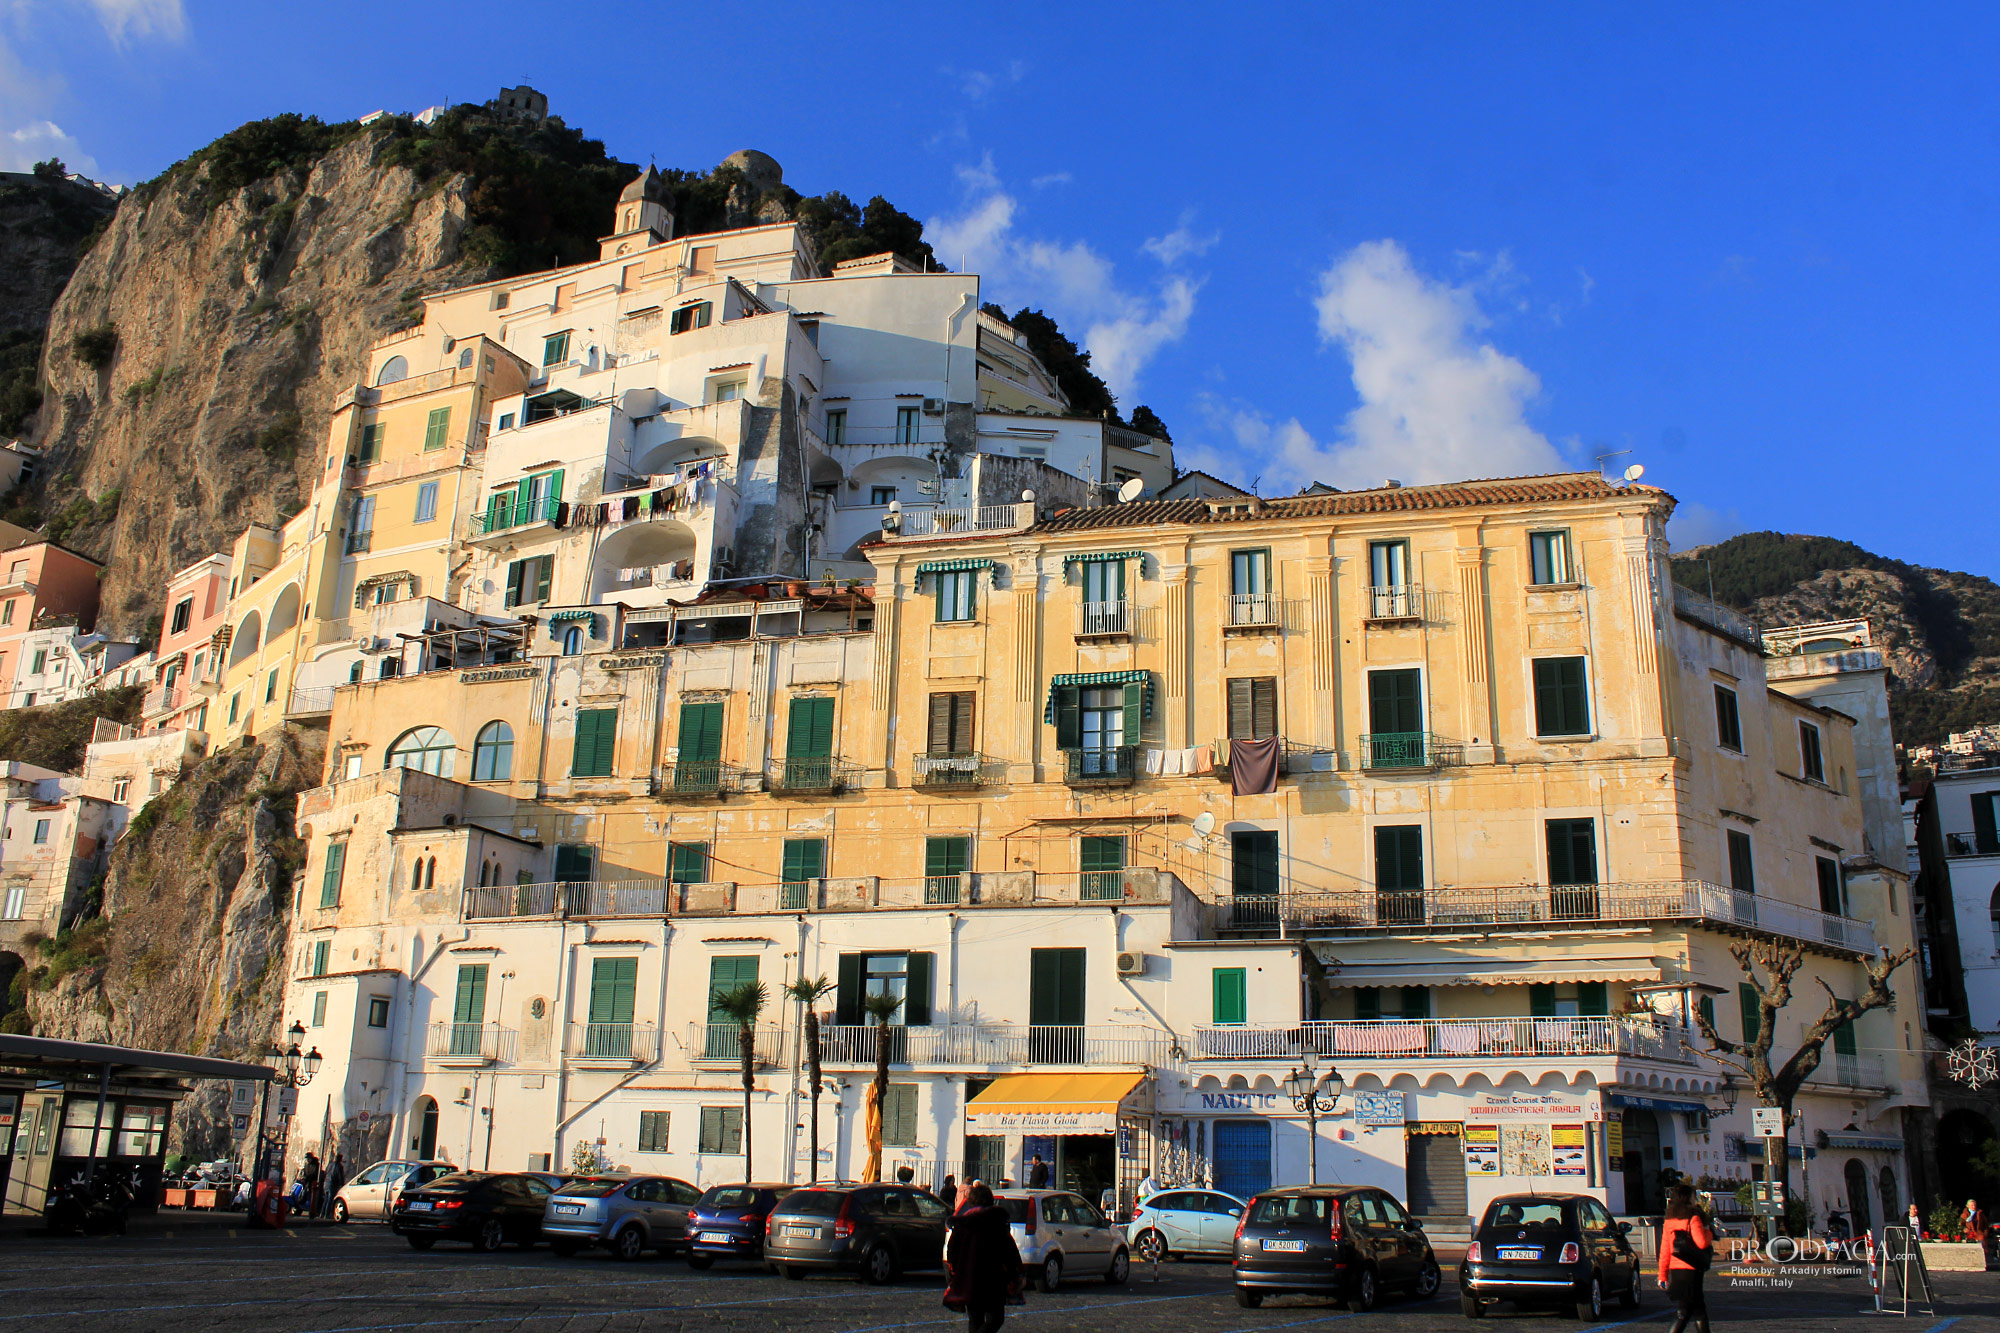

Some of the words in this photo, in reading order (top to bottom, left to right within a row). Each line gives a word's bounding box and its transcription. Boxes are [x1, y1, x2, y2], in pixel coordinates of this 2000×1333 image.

[599, 655, 664, 670] CAPRICE
[459, 667, 542, 684] RESIDENCE
[1201, 1093, 1277, 1109] NAUTIC
[1486, 1096, 1510, 1104] Travel
[1512, 1096, 1538, 1104] Tourist
[1540, 1096, 1563, 1104] Office
[1623, 1096, 1639, 1105] TRAVEL
[1549, 1105, 1581, 1113] AMALFI
[236, 1118, 245, 1128] P
[1001, 1116, 1018, 1125] Bar
[1022, 1116, 1050, 1125] Flavio
[1053, 1115, 1079, 1125] Gioia
[1430, 1123, 1438, 1131] JET
[1439, 1123, 1459, 1131] TICKETS
[1503, 1250, 1512, 1259] EN
